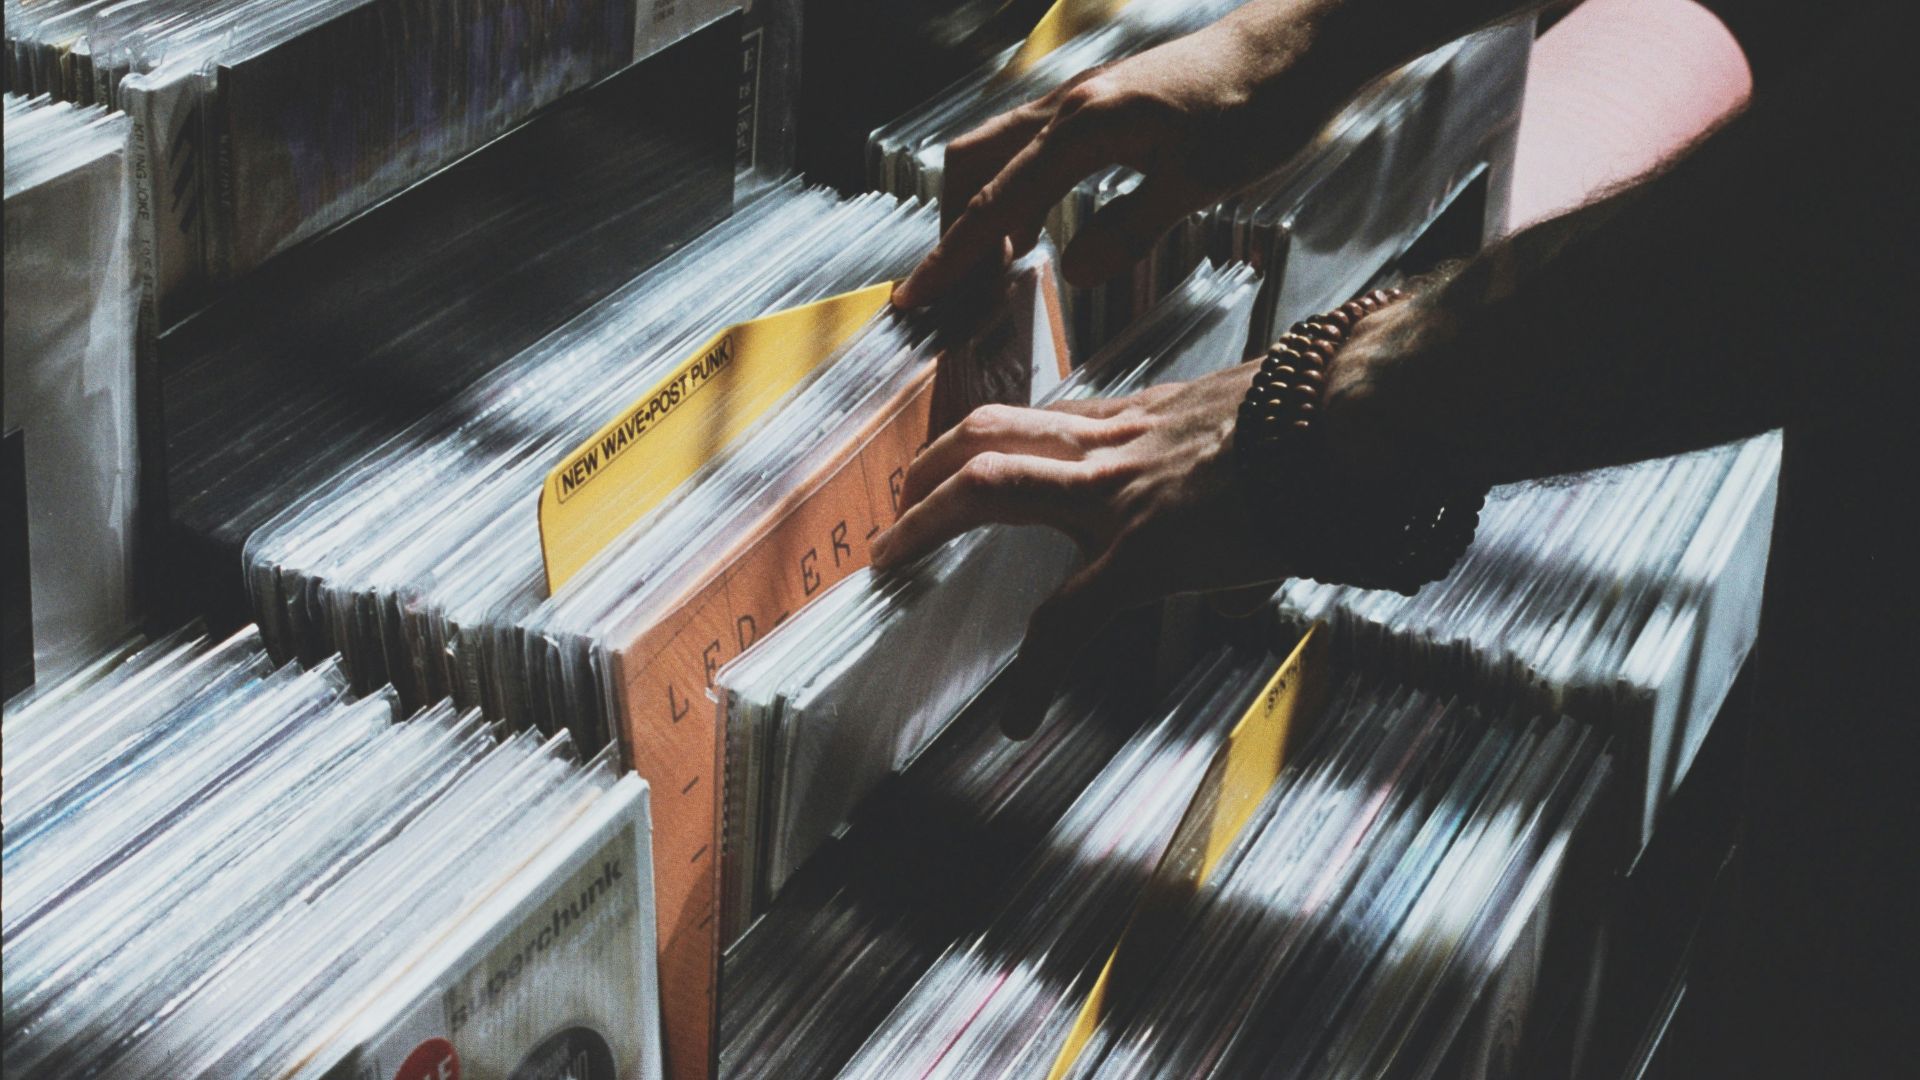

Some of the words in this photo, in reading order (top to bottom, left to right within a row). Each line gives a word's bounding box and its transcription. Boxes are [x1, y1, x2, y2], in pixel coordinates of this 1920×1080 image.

[136, 181, 150, 221] JOKE
[561, 447, 599, 495] NEW
[690, 341, 729, 387] PUNK
